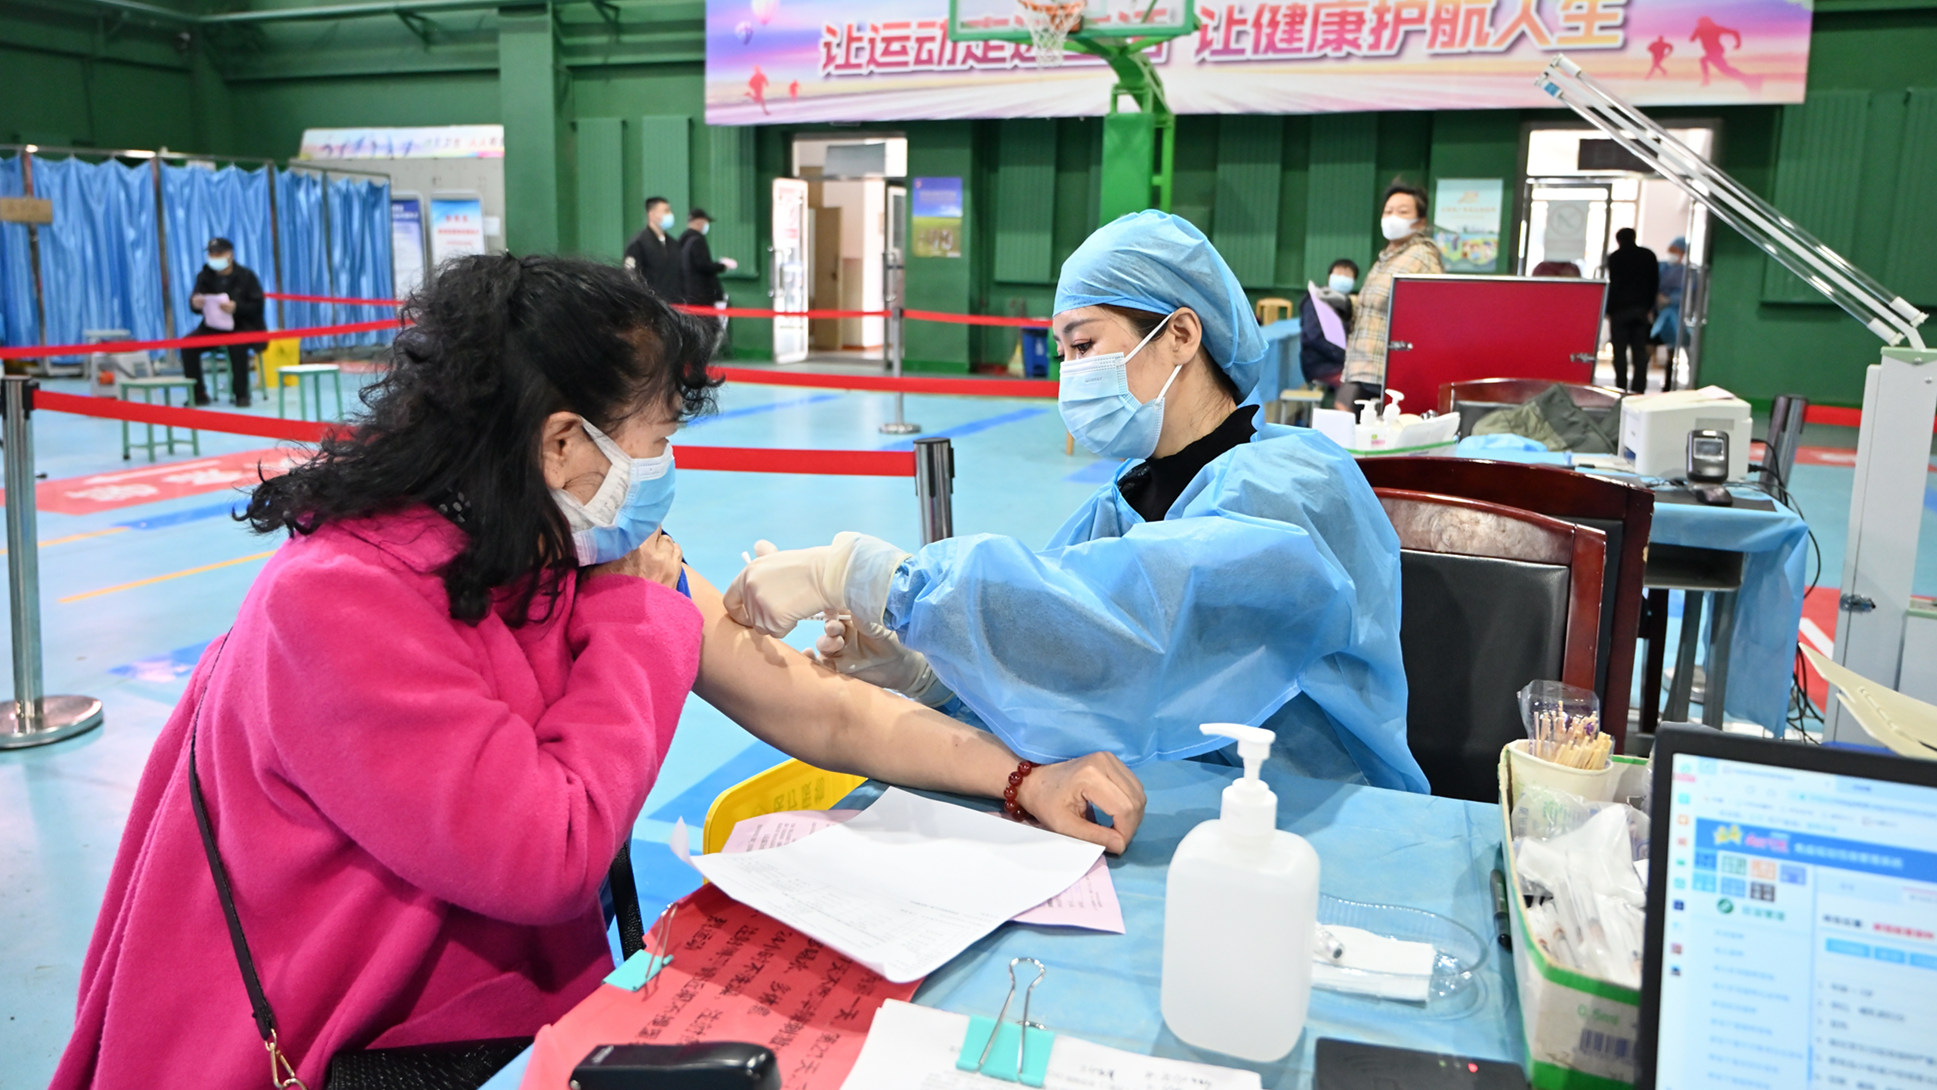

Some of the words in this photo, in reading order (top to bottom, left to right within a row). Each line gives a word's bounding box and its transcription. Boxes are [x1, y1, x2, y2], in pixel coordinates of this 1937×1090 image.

[822, 9, 1166, 75] 让运动走
[1195, 0, 1627, 60] 让健康护航人生
